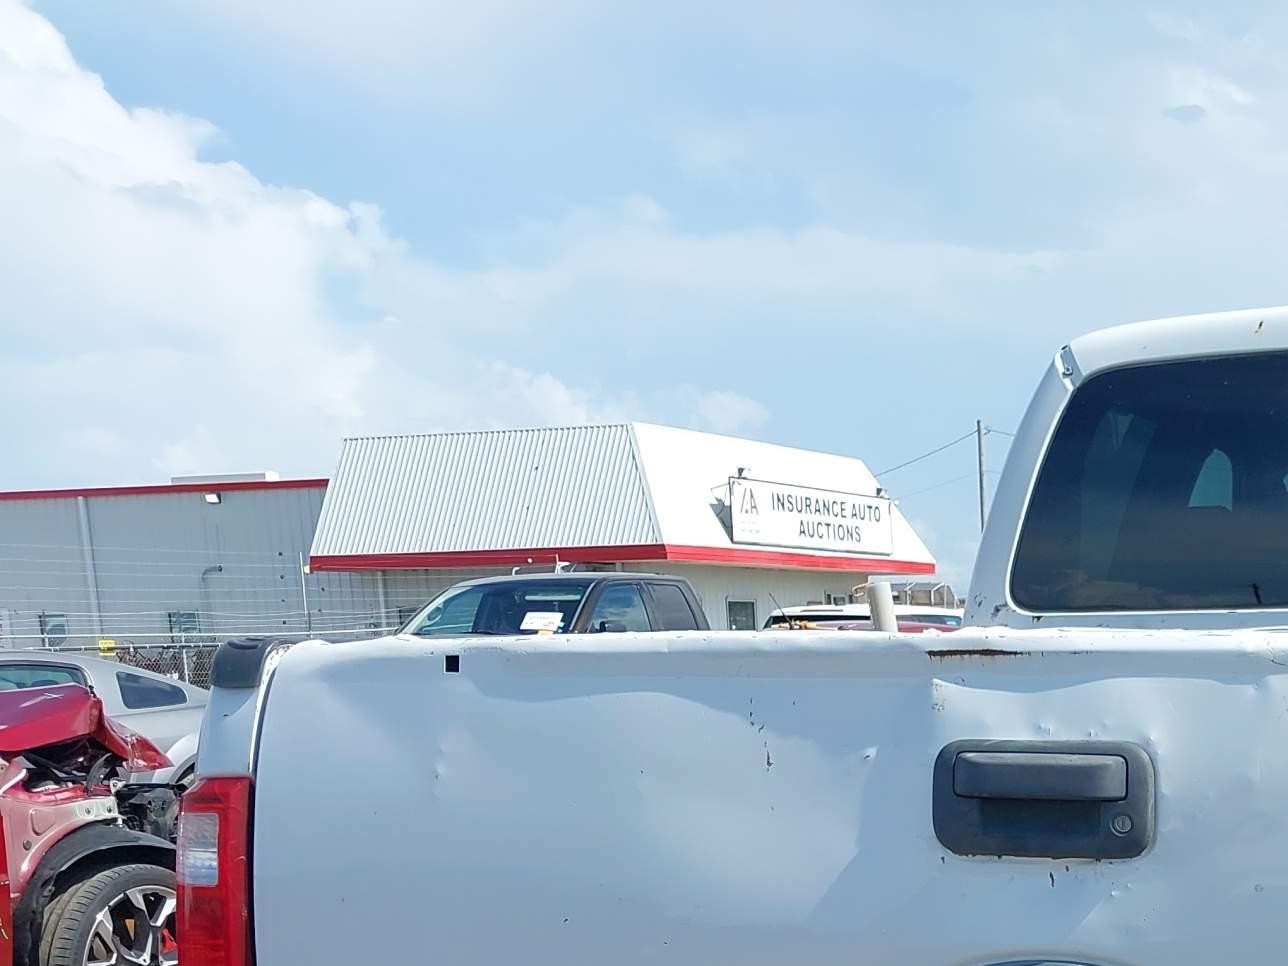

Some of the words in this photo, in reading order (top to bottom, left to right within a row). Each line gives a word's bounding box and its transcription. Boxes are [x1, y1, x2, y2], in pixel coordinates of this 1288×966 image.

[771, 491, 847, 519] INSURANCE
[851, 503, 881, 523] AUTO
[799, 519, 861, 543] AUCTIONS
